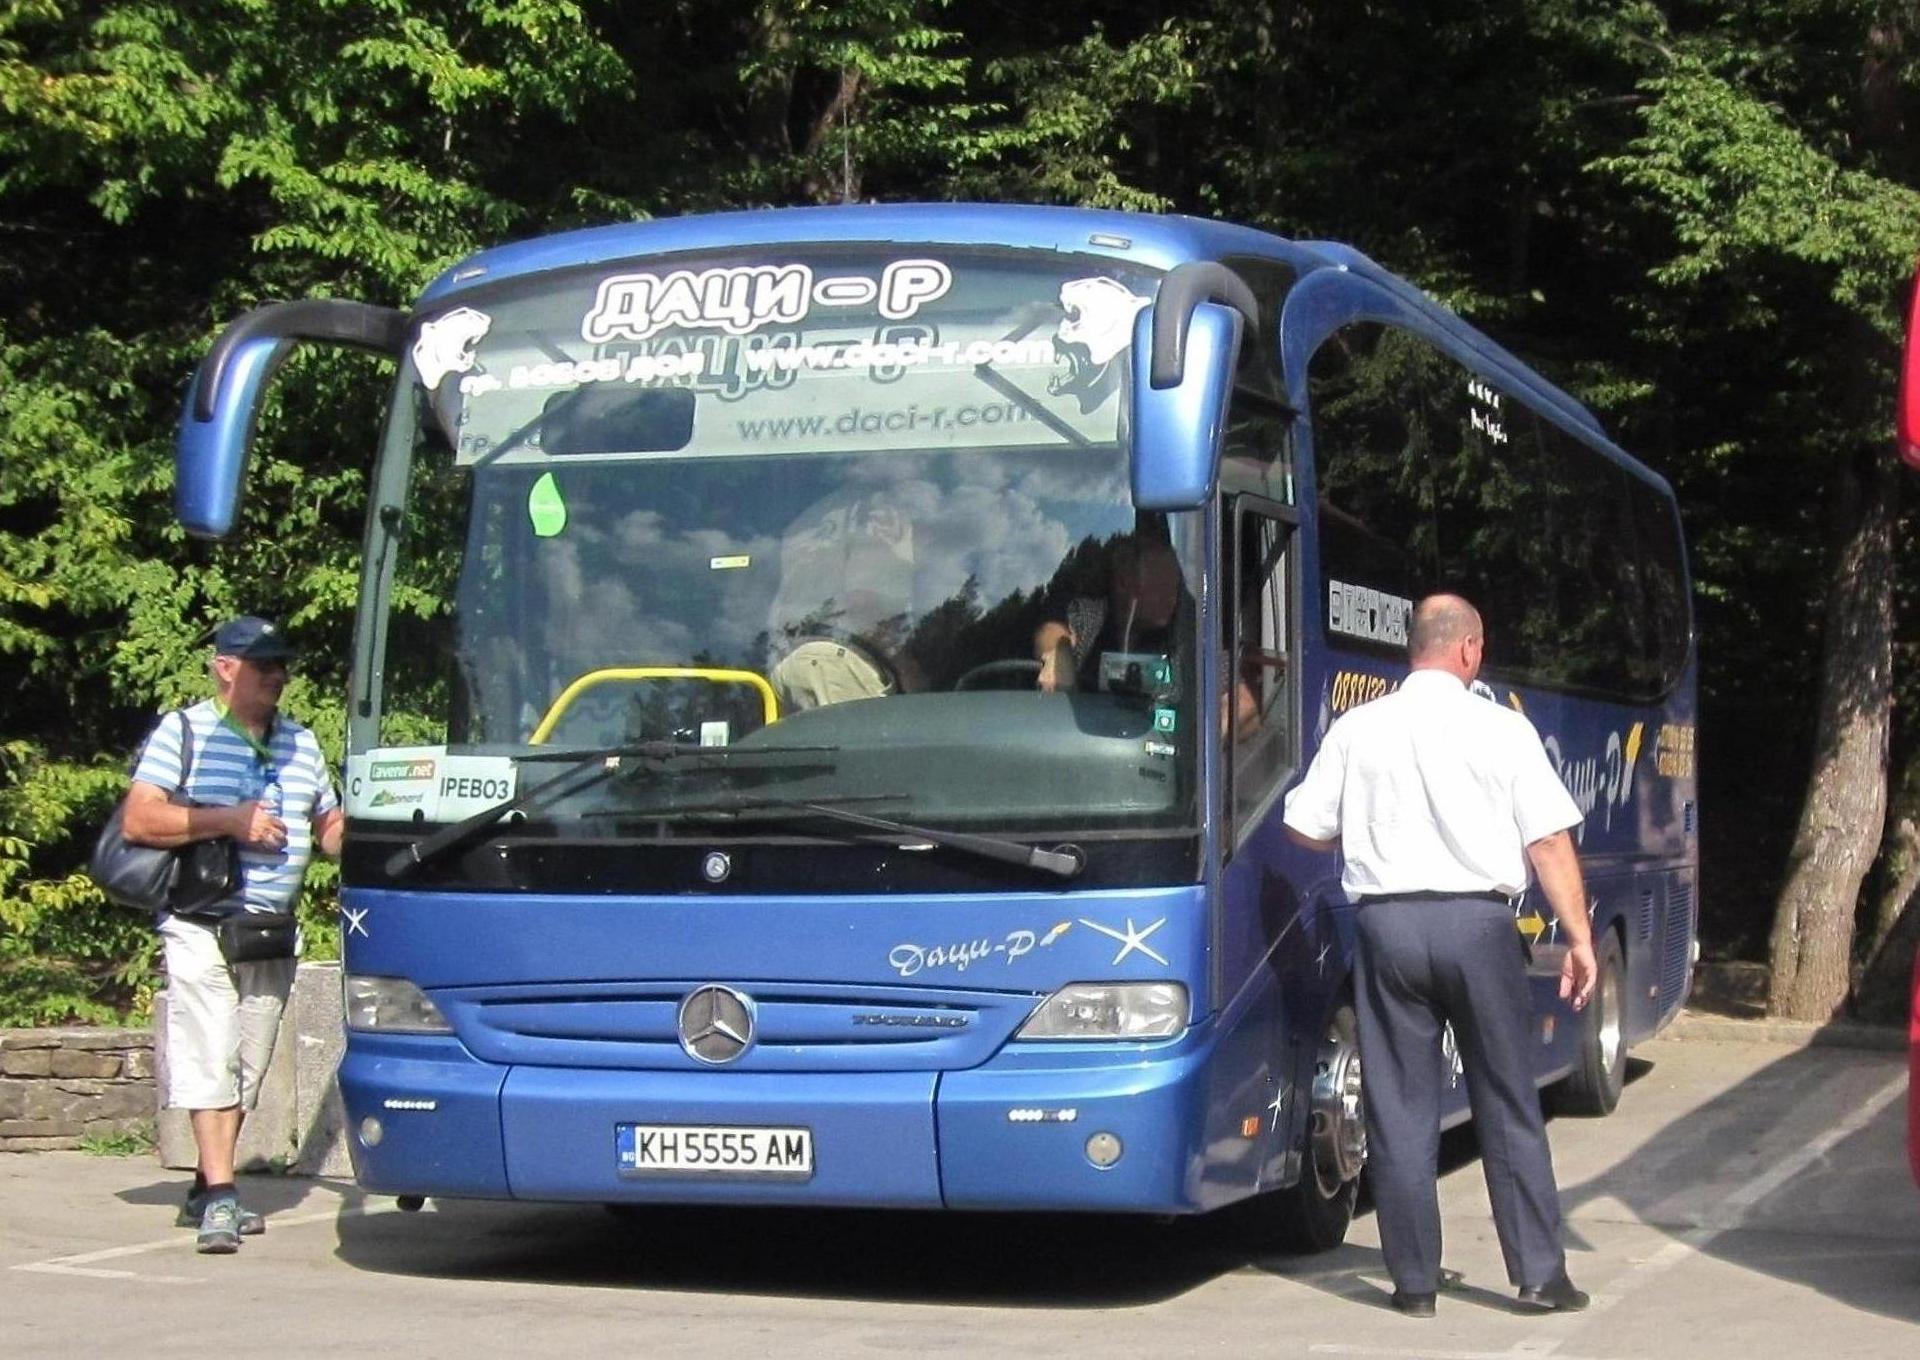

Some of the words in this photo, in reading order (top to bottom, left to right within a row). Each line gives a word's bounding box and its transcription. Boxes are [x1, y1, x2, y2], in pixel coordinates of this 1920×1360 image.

[745, 338, 1056, 371] www.daci-r.com
[684, 1133, 758, 1165] 5555
[765, 1134, 804, 1166] AM
